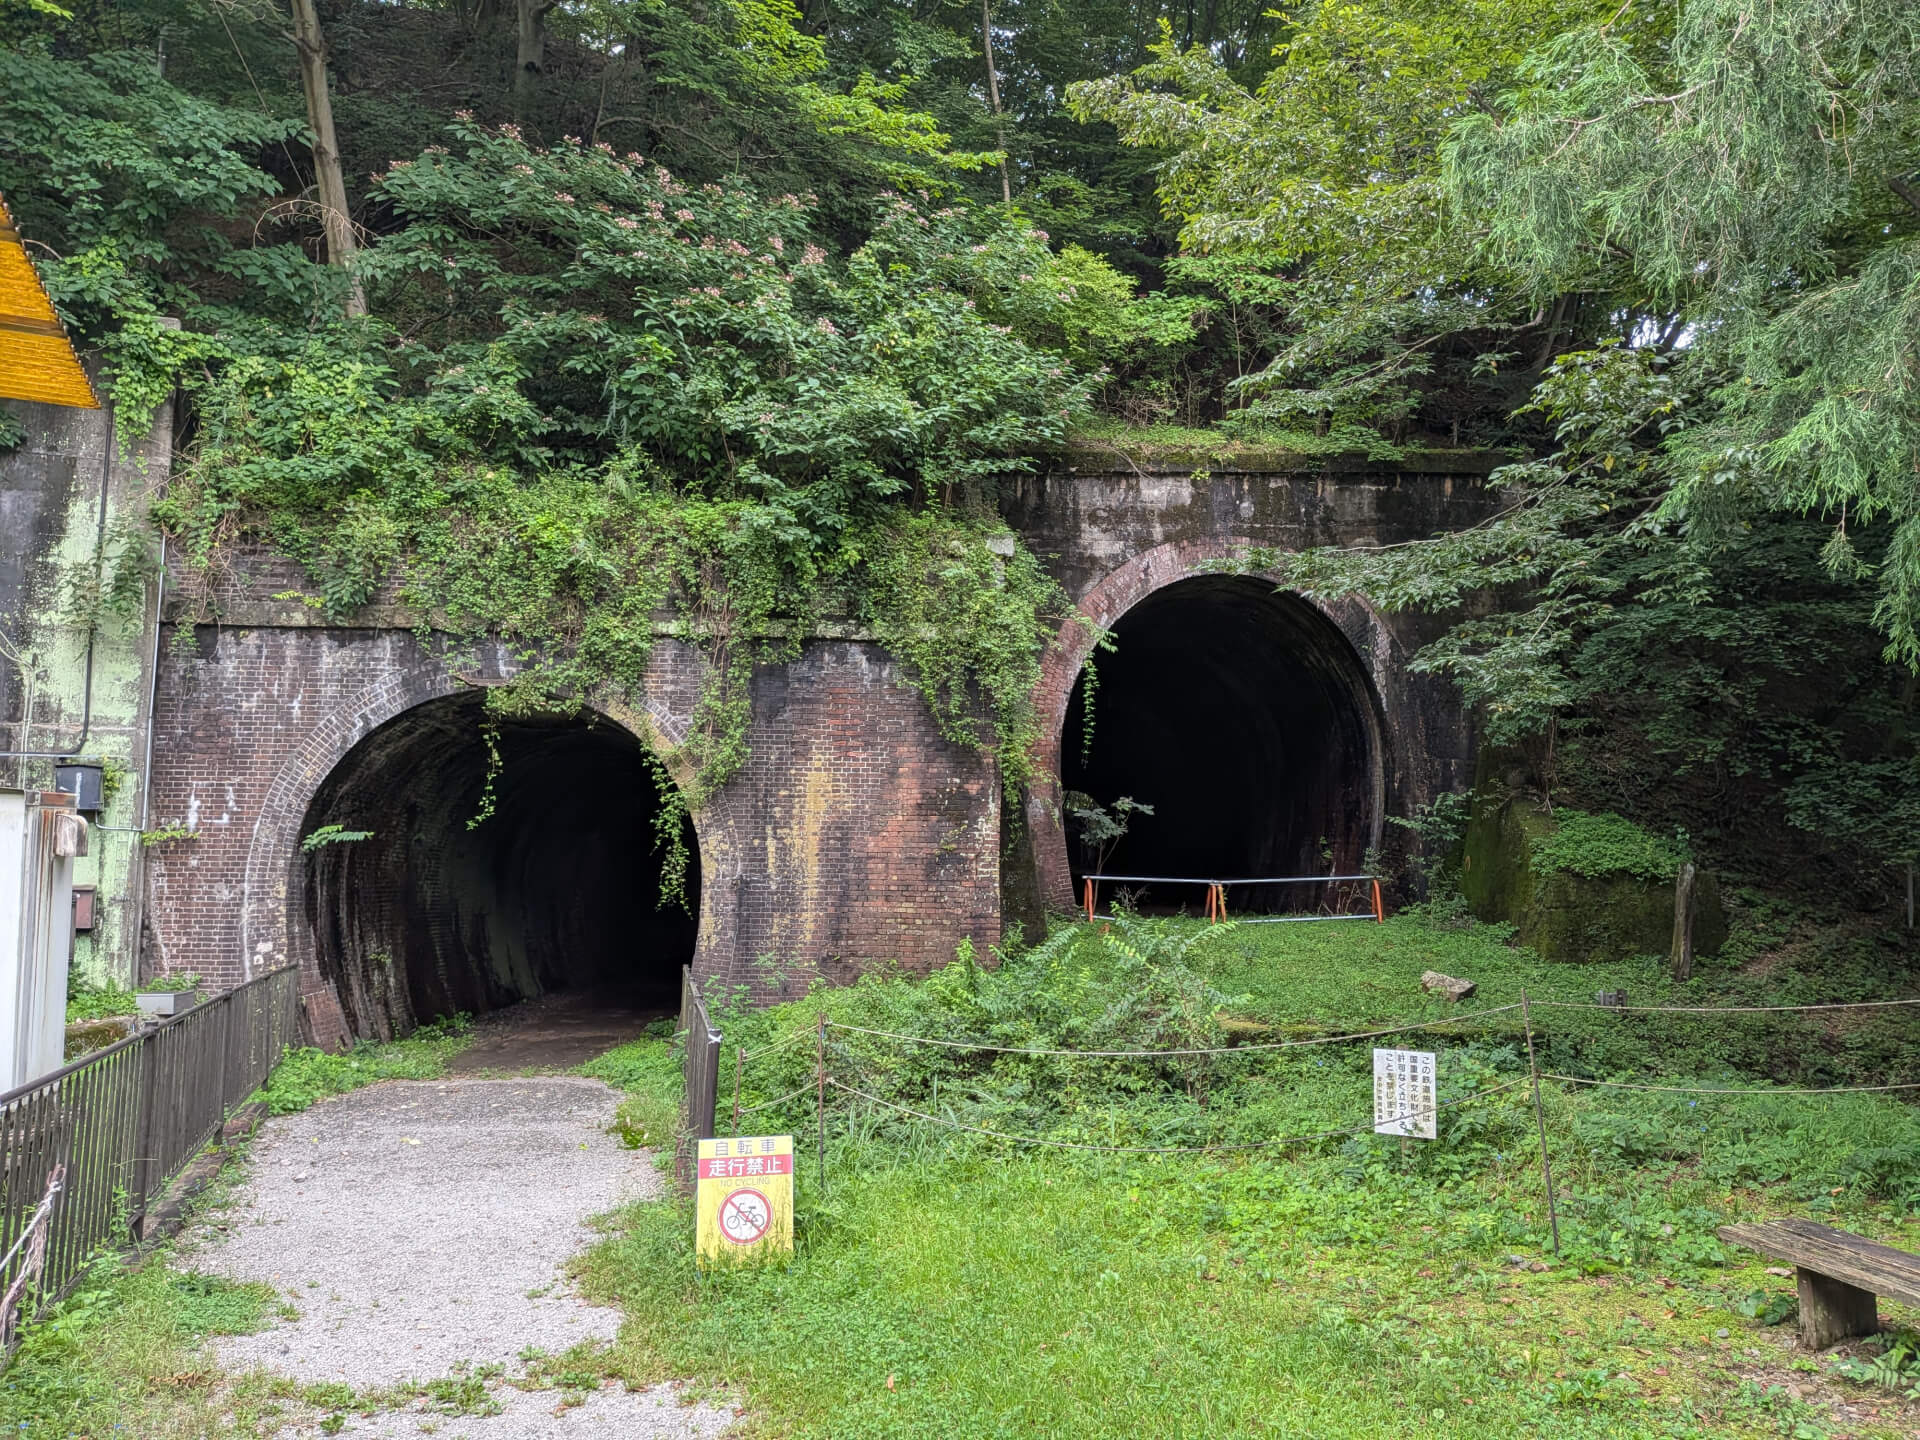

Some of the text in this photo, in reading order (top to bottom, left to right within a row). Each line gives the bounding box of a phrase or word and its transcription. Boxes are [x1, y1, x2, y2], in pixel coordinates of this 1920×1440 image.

[1398, 1052, 1407, 1130] 許可なく立ち入る
[715, 1138, 776, 1156] 自転車
[708, 1156, 784, 1177] 走行禁止
